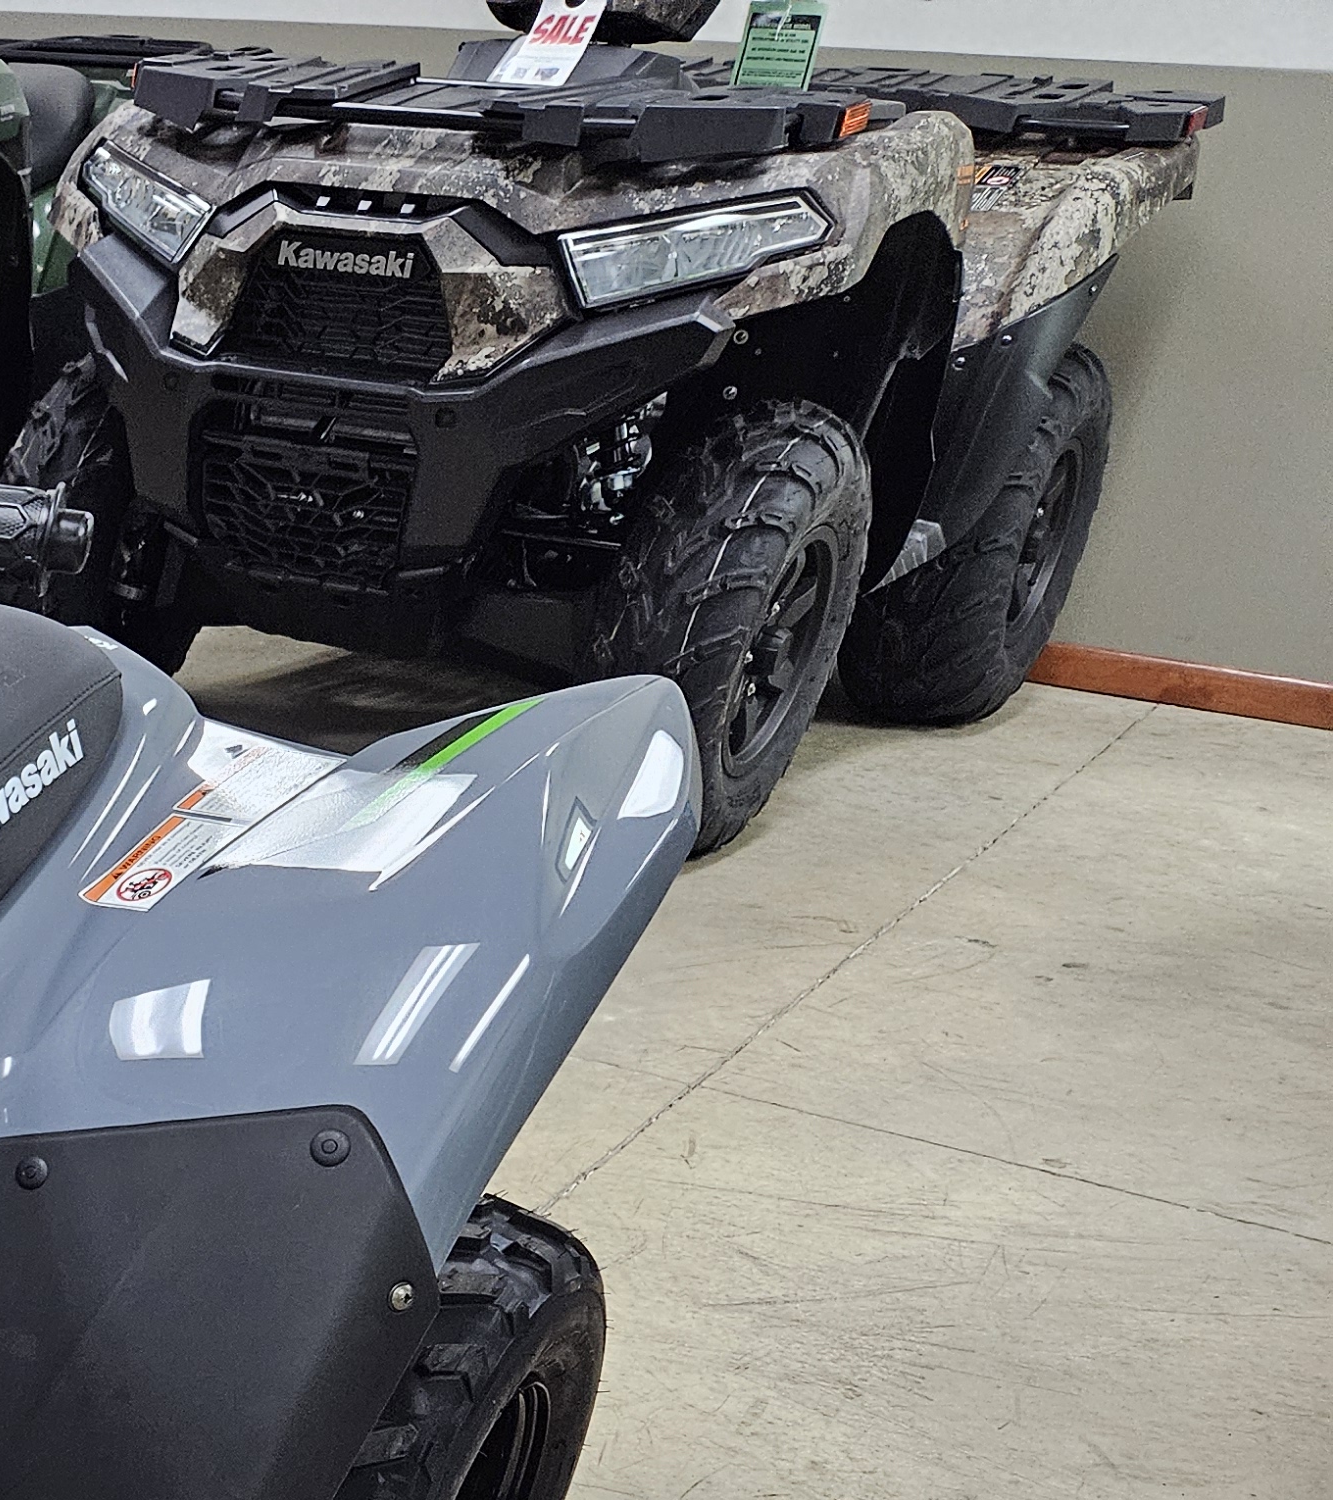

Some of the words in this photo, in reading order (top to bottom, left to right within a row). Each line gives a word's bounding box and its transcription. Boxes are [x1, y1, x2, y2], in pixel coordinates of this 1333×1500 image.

[529, 14, 597, 45] SALE
[278, 240, 414, 278] Kawasaki
[120, 835, 161, 870] WARNING
